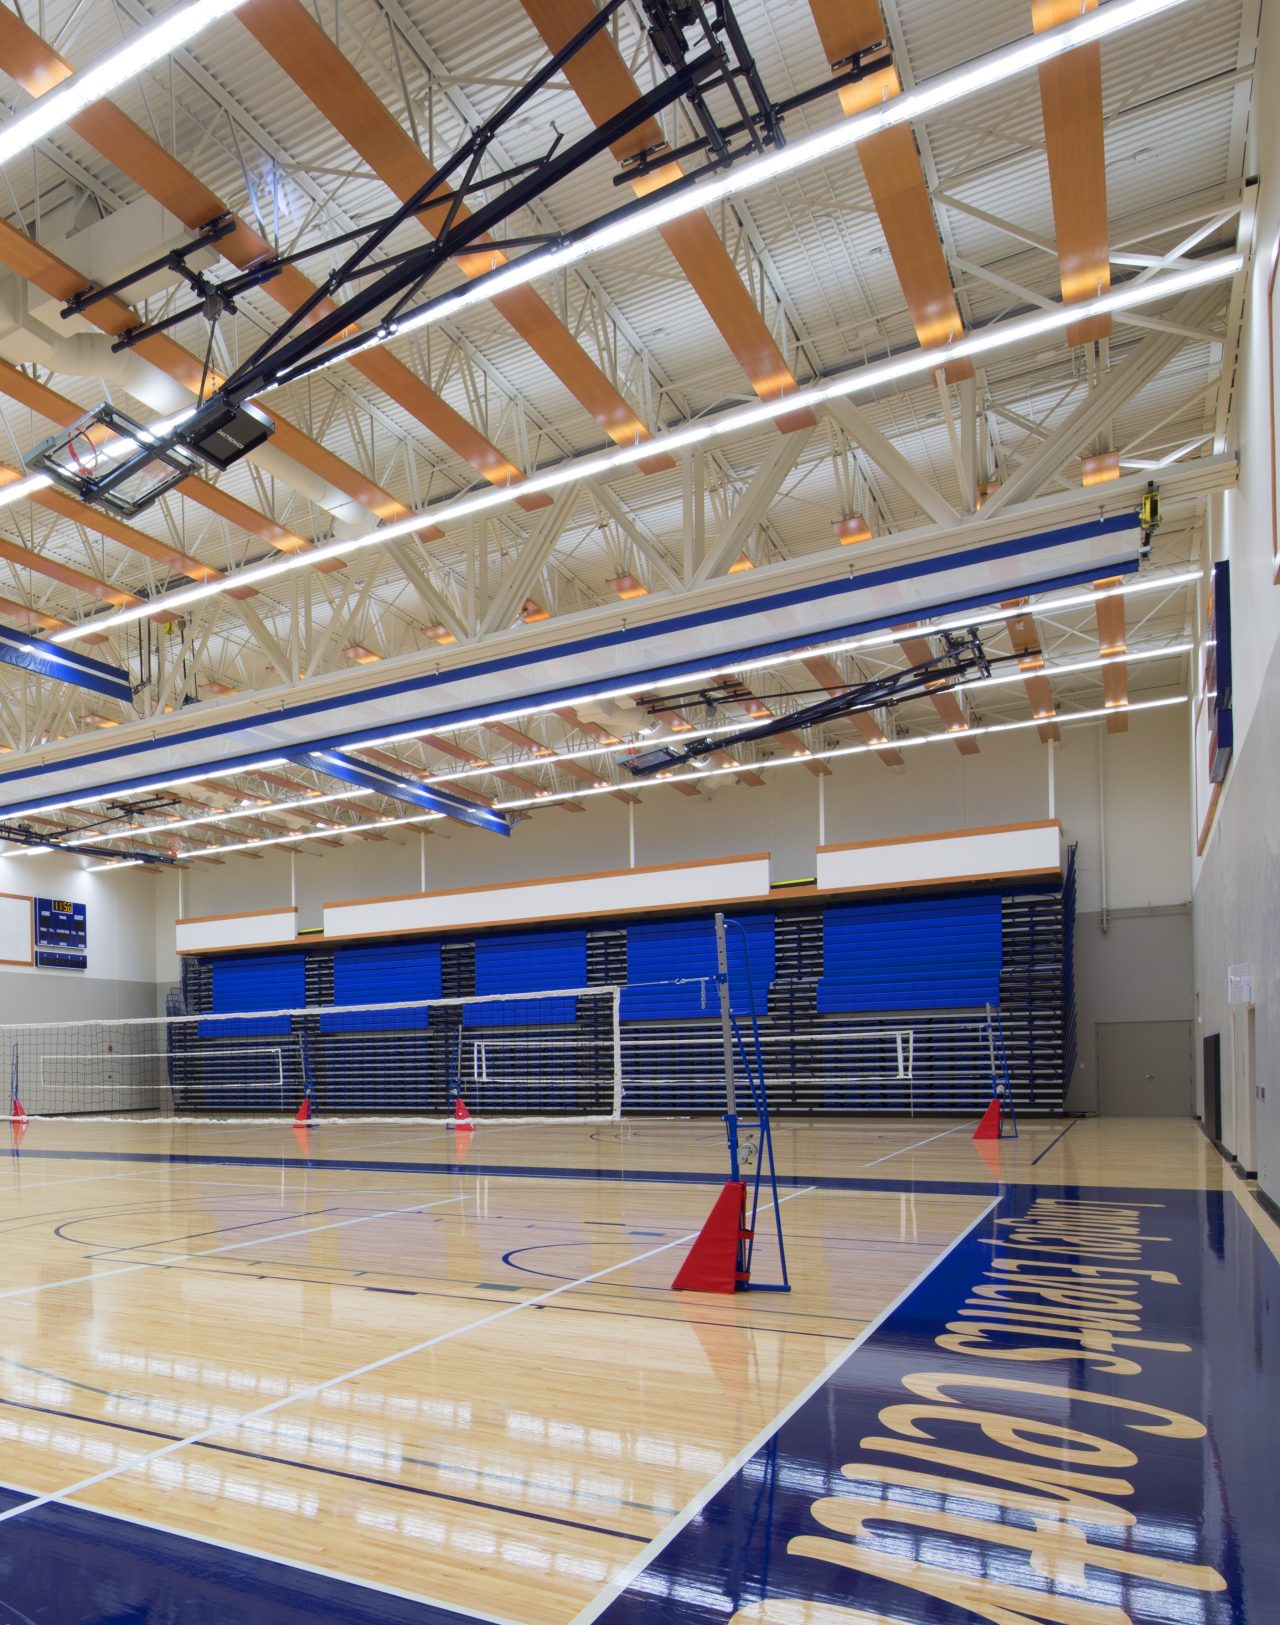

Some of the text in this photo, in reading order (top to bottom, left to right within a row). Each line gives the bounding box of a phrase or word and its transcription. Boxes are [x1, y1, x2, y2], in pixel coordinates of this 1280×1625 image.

[728, 1199, 1227, 1625] Langley Events Centr
